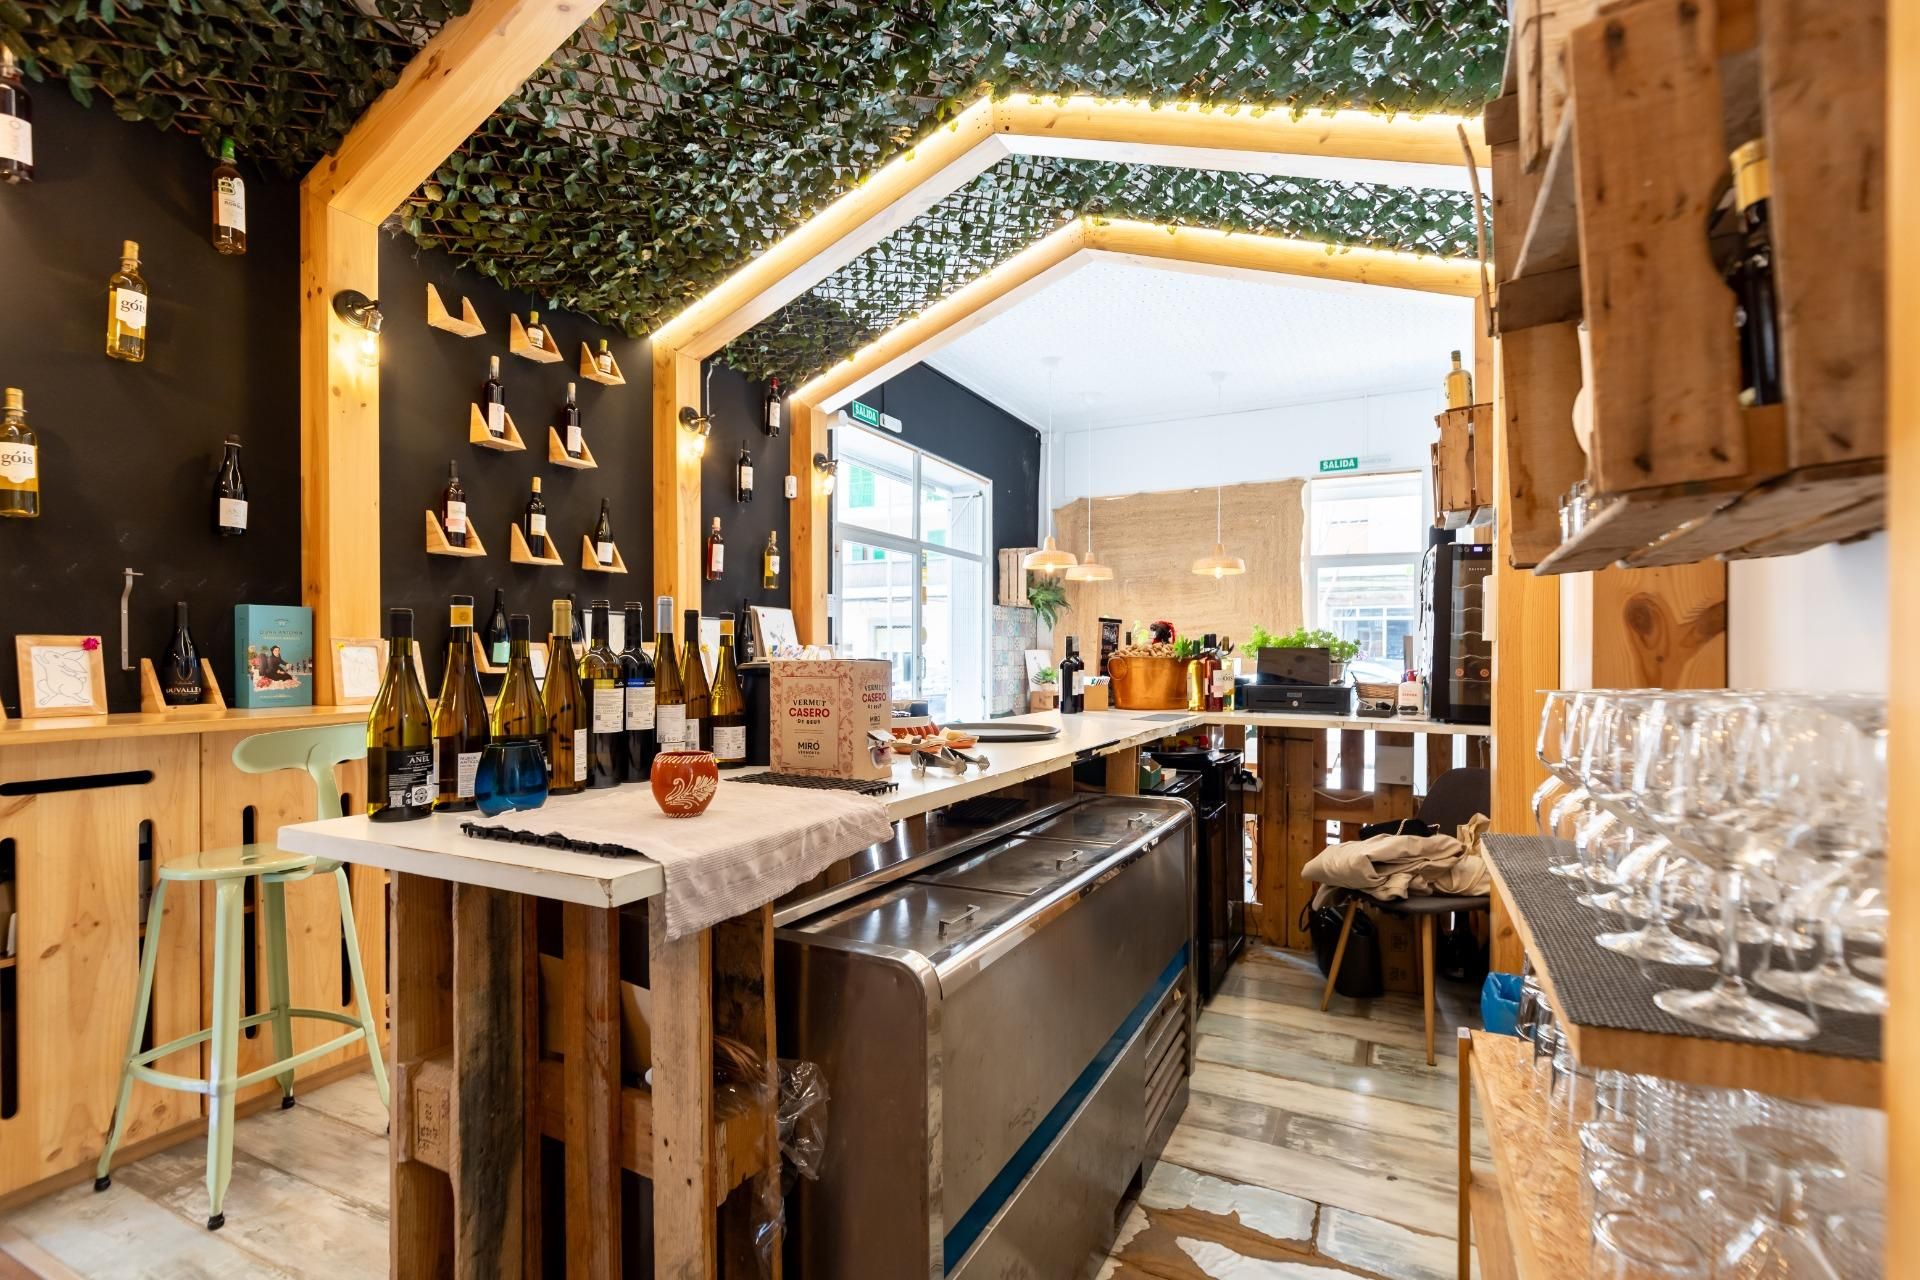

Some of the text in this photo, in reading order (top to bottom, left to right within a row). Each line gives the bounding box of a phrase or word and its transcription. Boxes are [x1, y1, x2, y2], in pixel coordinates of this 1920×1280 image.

[855, 403, 877, 422] SALIDA
[1, 450, 33, 467] góis
[1322, 458, 1355, 470] SALIDA
[793, 699, 826, 707] VERMUT
[861, 692, 887, 703] CASERO
[789, 708, 829, 718] CASERO
[797, 740, 820, 751] MIRÓ
